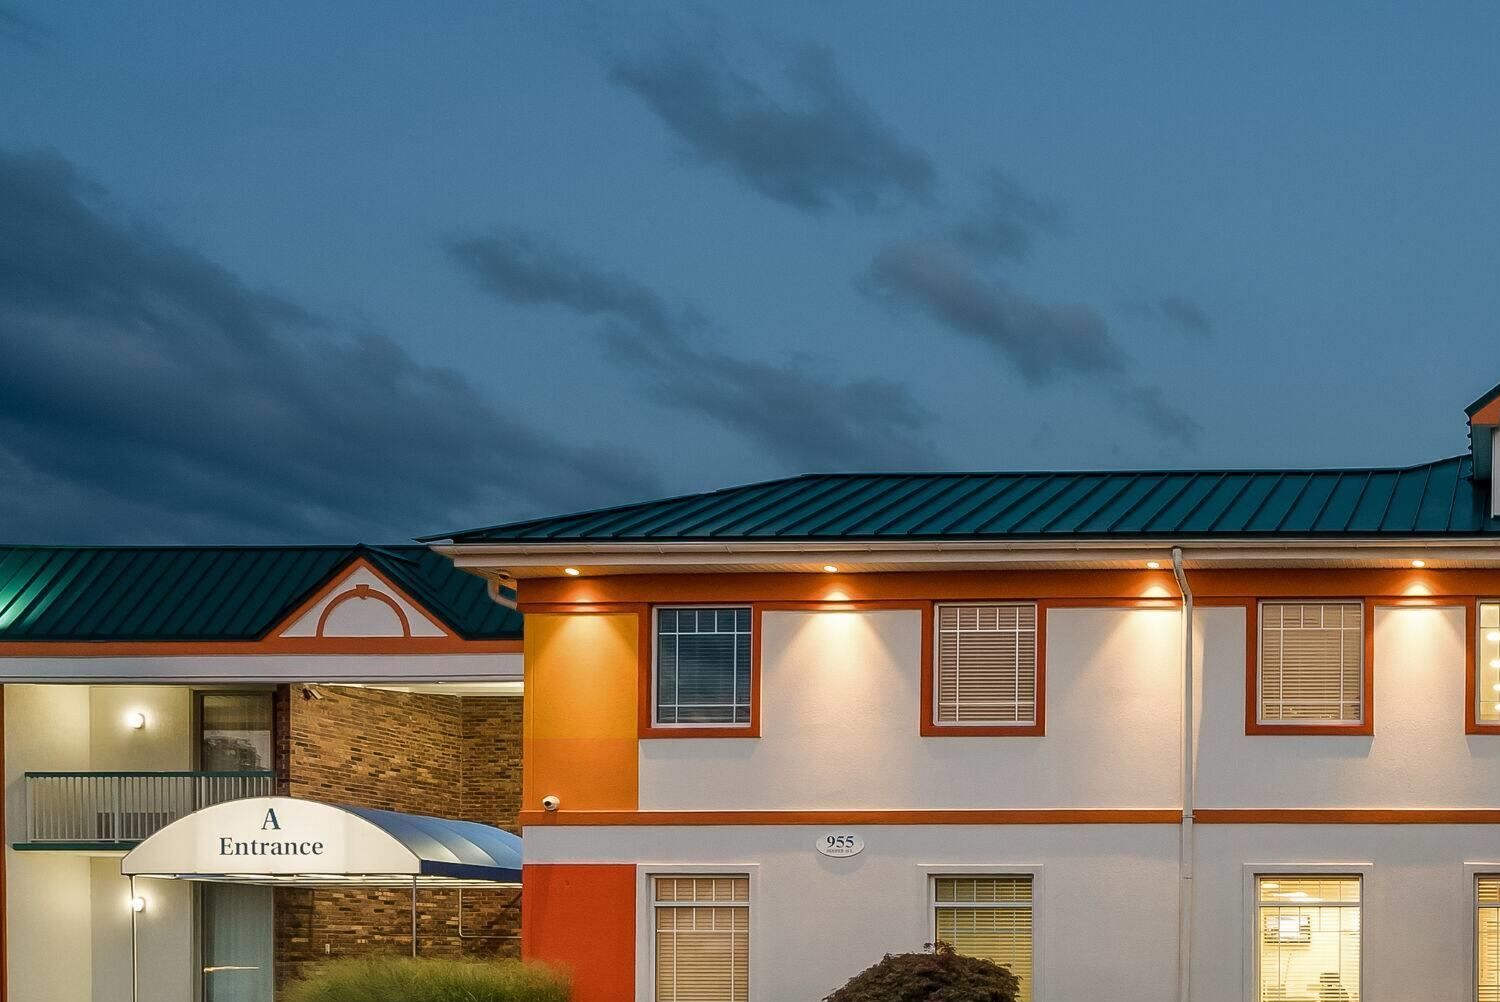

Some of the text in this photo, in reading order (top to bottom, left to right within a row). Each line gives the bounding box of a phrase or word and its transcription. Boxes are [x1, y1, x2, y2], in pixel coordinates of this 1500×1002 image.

[261, 808, 280, 830] A
[219, 837, 324, 856] Entrance
[826, 835, 854, 848] 955
